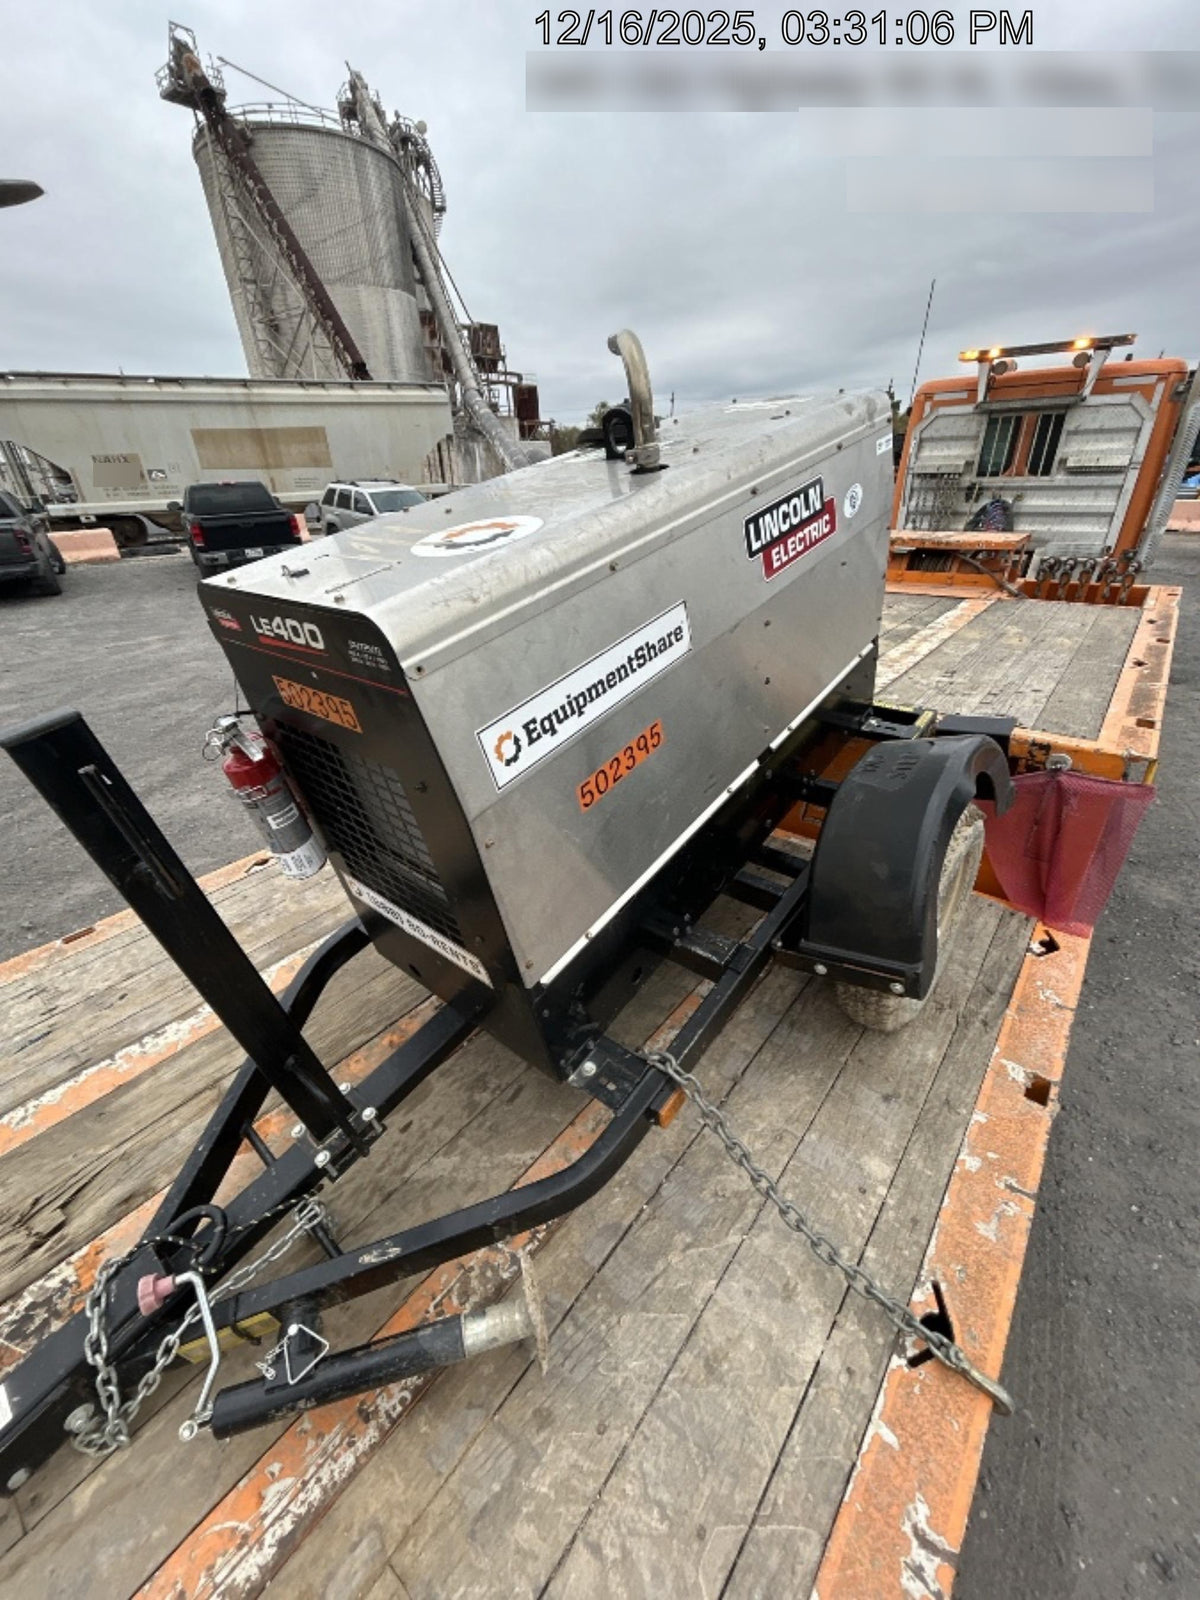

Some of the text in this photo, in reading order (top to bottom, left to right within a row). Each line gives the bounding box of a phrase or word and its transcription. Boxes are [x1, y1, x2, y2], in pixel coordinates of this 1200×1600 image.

[748, 484, 822, 552] LINCOLN
[771, 513, 831, 570] ELECTRIC
[250, 614, 325, 650] LE400
[276, 679, 359, 730] 502395
[521, 623, 685, 748] EquipmentShare
[579, 721, 662, 810] 502395
